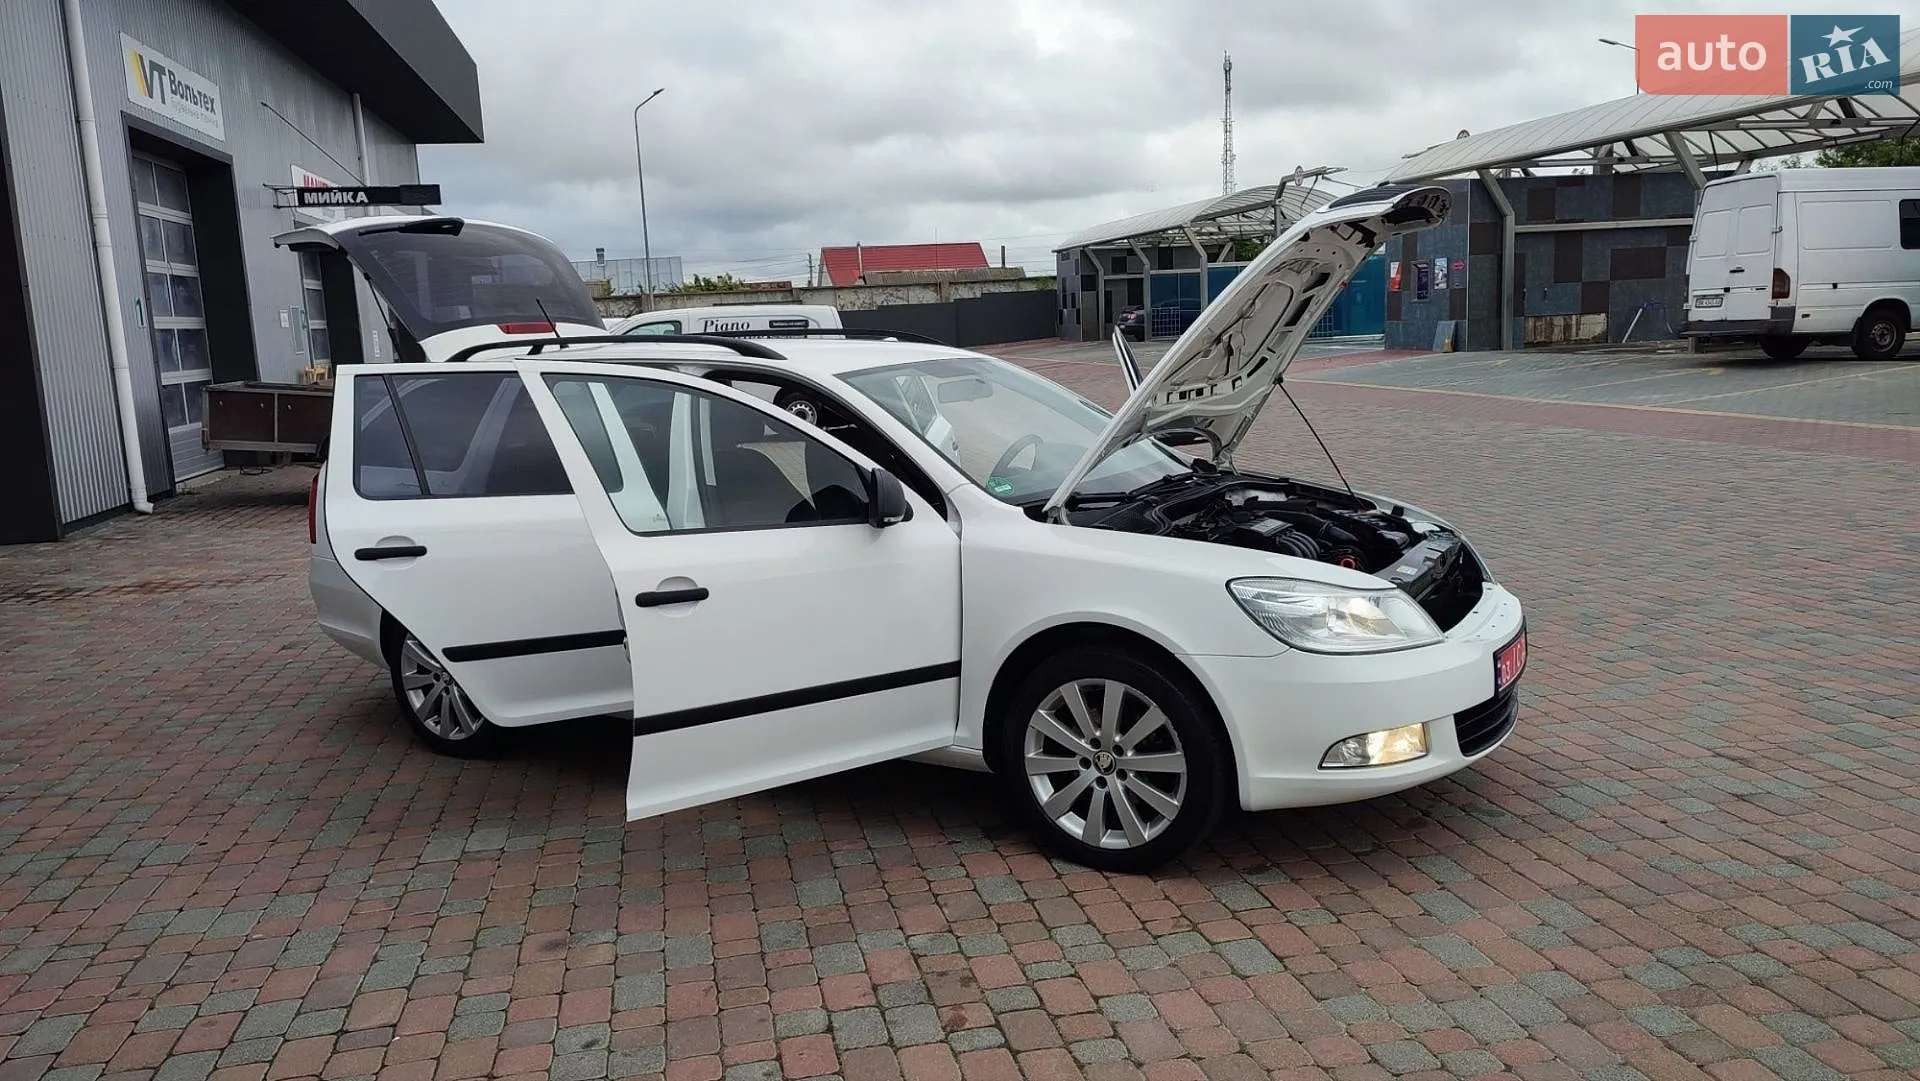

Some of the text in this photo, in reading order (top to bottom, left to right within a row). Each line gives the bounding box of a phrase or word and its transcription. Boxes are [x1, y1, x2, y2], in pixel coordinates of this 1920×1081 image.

[168, 69, 216, 115] Вольтех
[303, 189, 369, 205] МИЙКА
[703, 319, 750, 332] Piano
